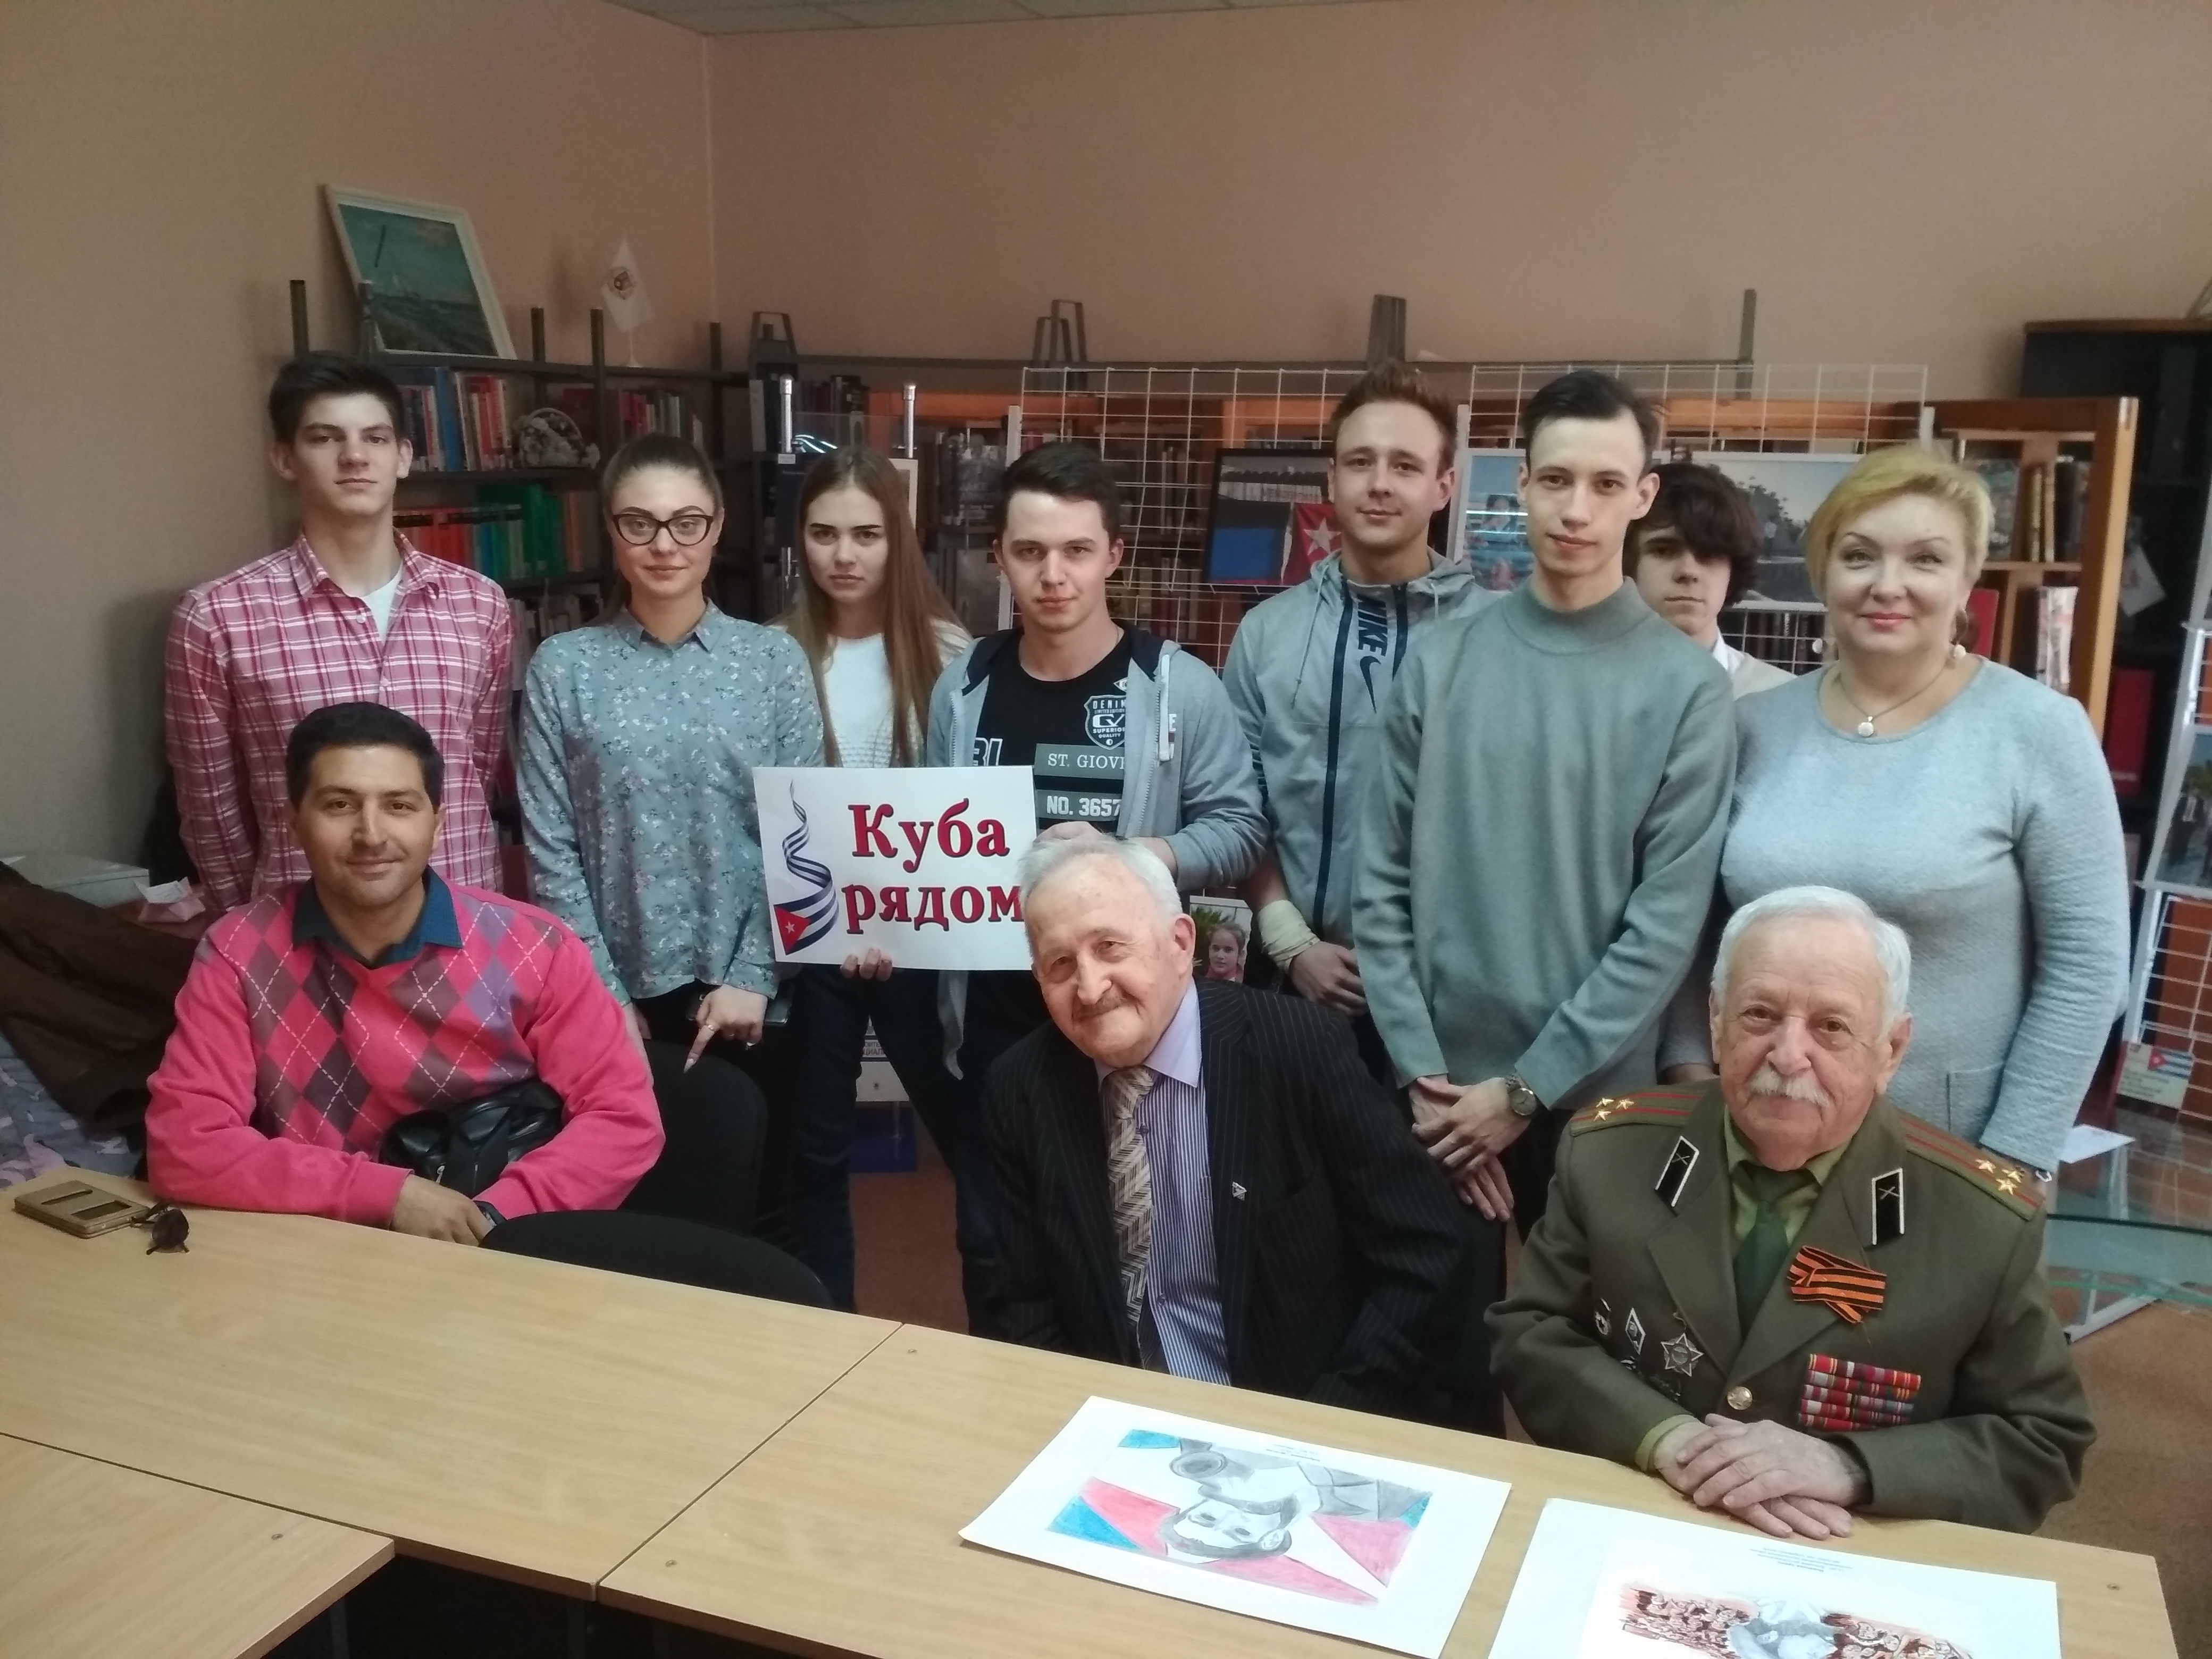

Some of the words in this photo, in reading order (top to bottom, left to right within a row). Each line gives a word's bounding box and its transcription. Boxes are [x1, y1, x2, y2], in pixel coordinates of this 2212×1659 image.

[1357, 594, 1388, 657] NIKE
[1048, 753, 1070, 767] ST.
[1046, 795, 1074, 816] NO.
[1078, 798, 1122, 817] 3657
[848, 797, 1010, 874] Куба
[841, 884, 1025, 935] рядом
